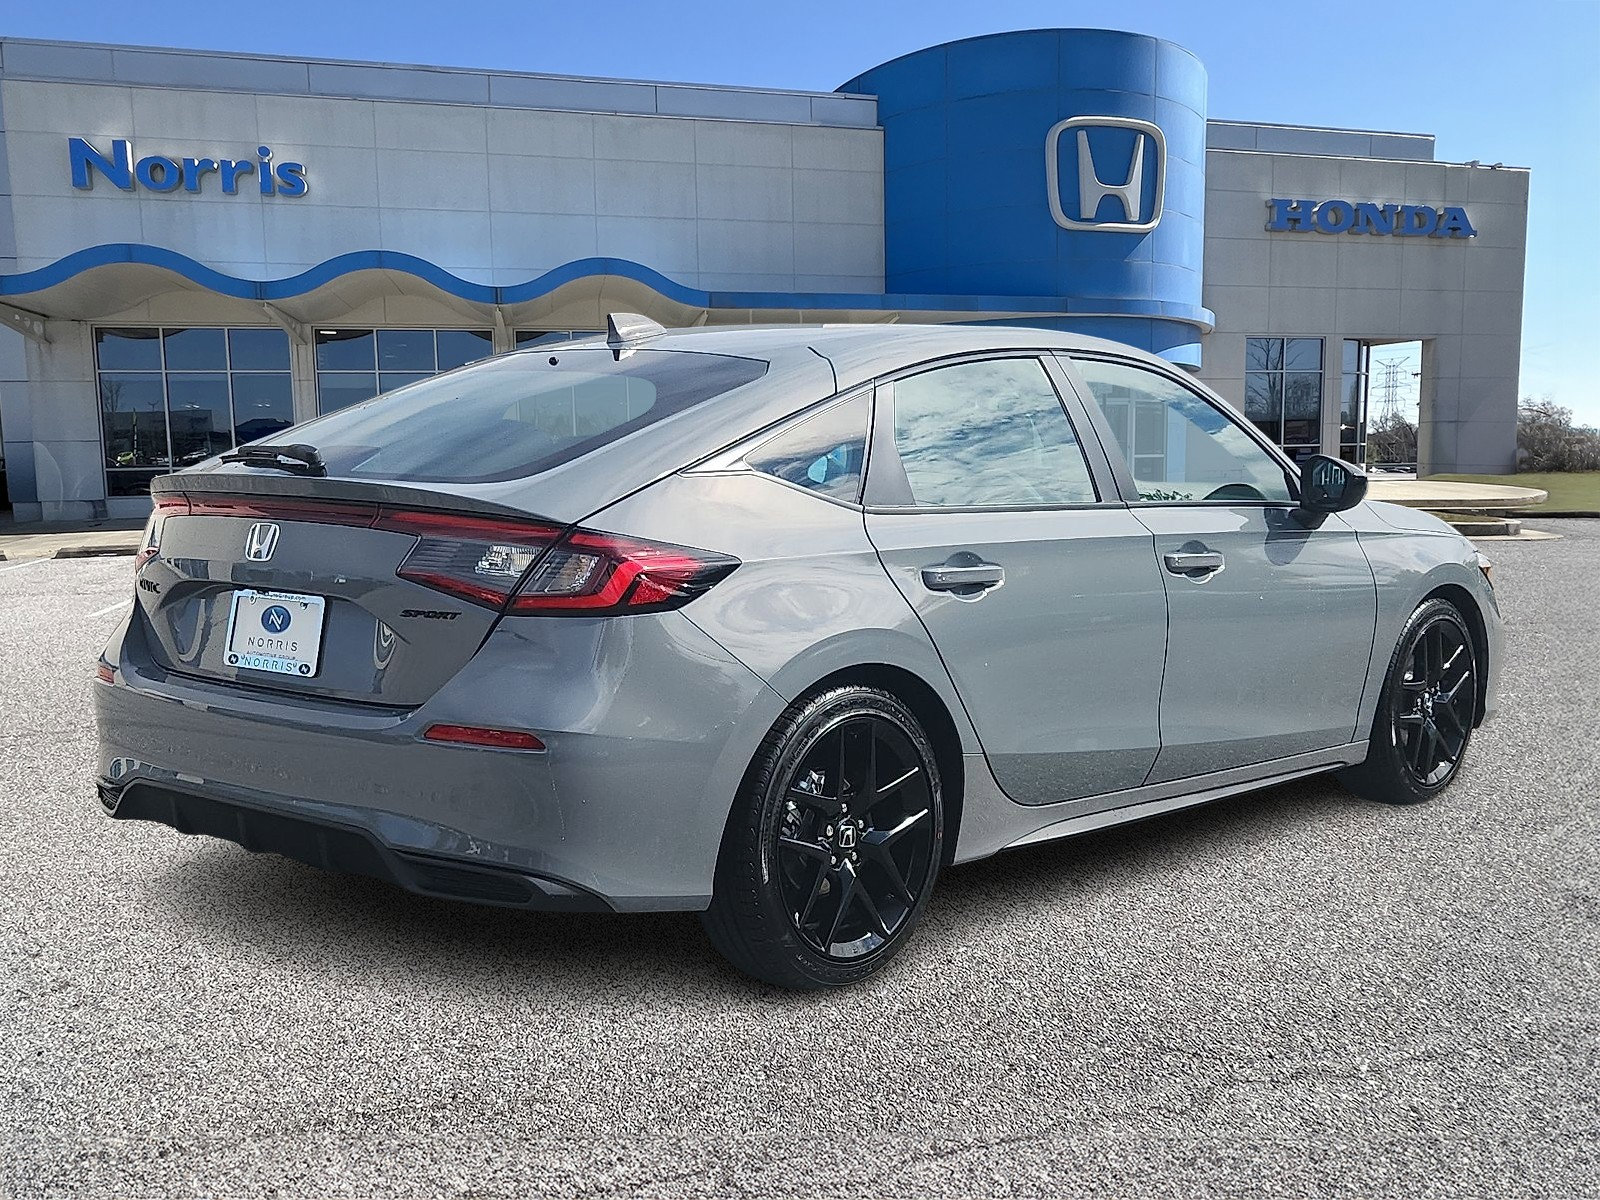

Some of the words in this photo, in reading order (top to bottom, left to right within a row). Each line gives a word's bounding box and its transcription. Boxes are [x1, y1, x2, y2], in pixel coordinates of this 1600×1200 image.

[68, 137, 308, 197] Norris
[1265, 198, 1478, 238] HONDA
[400, 609, 462, 620] SPORT
[248, 637, 298, 652] NORRIS
[244, 657, 293, 672] NORRIS
